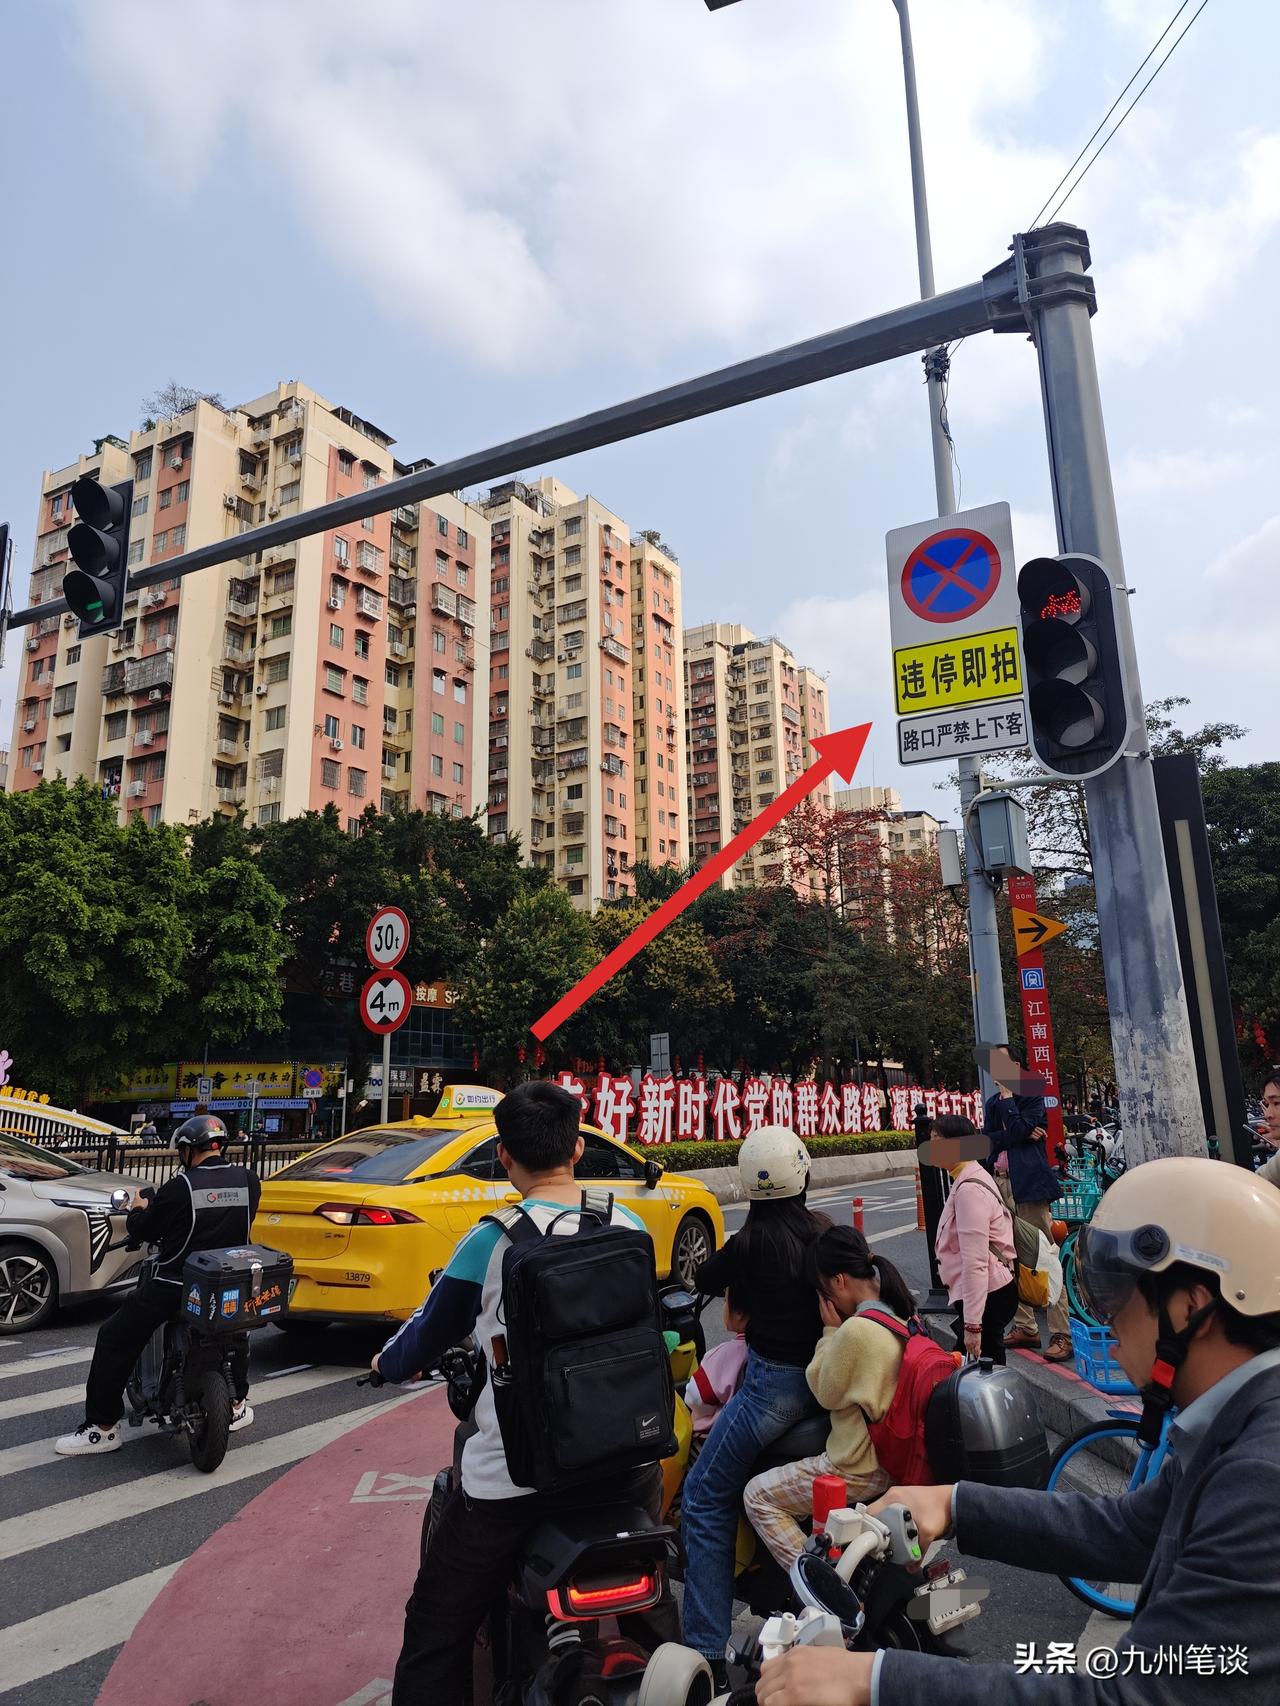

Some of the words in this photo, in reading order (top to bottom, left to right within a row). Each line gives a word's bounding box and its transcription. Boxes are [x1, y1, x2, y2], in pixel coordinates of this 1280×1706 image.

[900, 641, 1018, 700] 违停即拍
[903, 712, 1023, 752] 路口严禁上下客
[374, 924, 400, 952] 30t
[369, 990, 400, 1013] 4m
[345, 1272, 371, 1283] 13879
